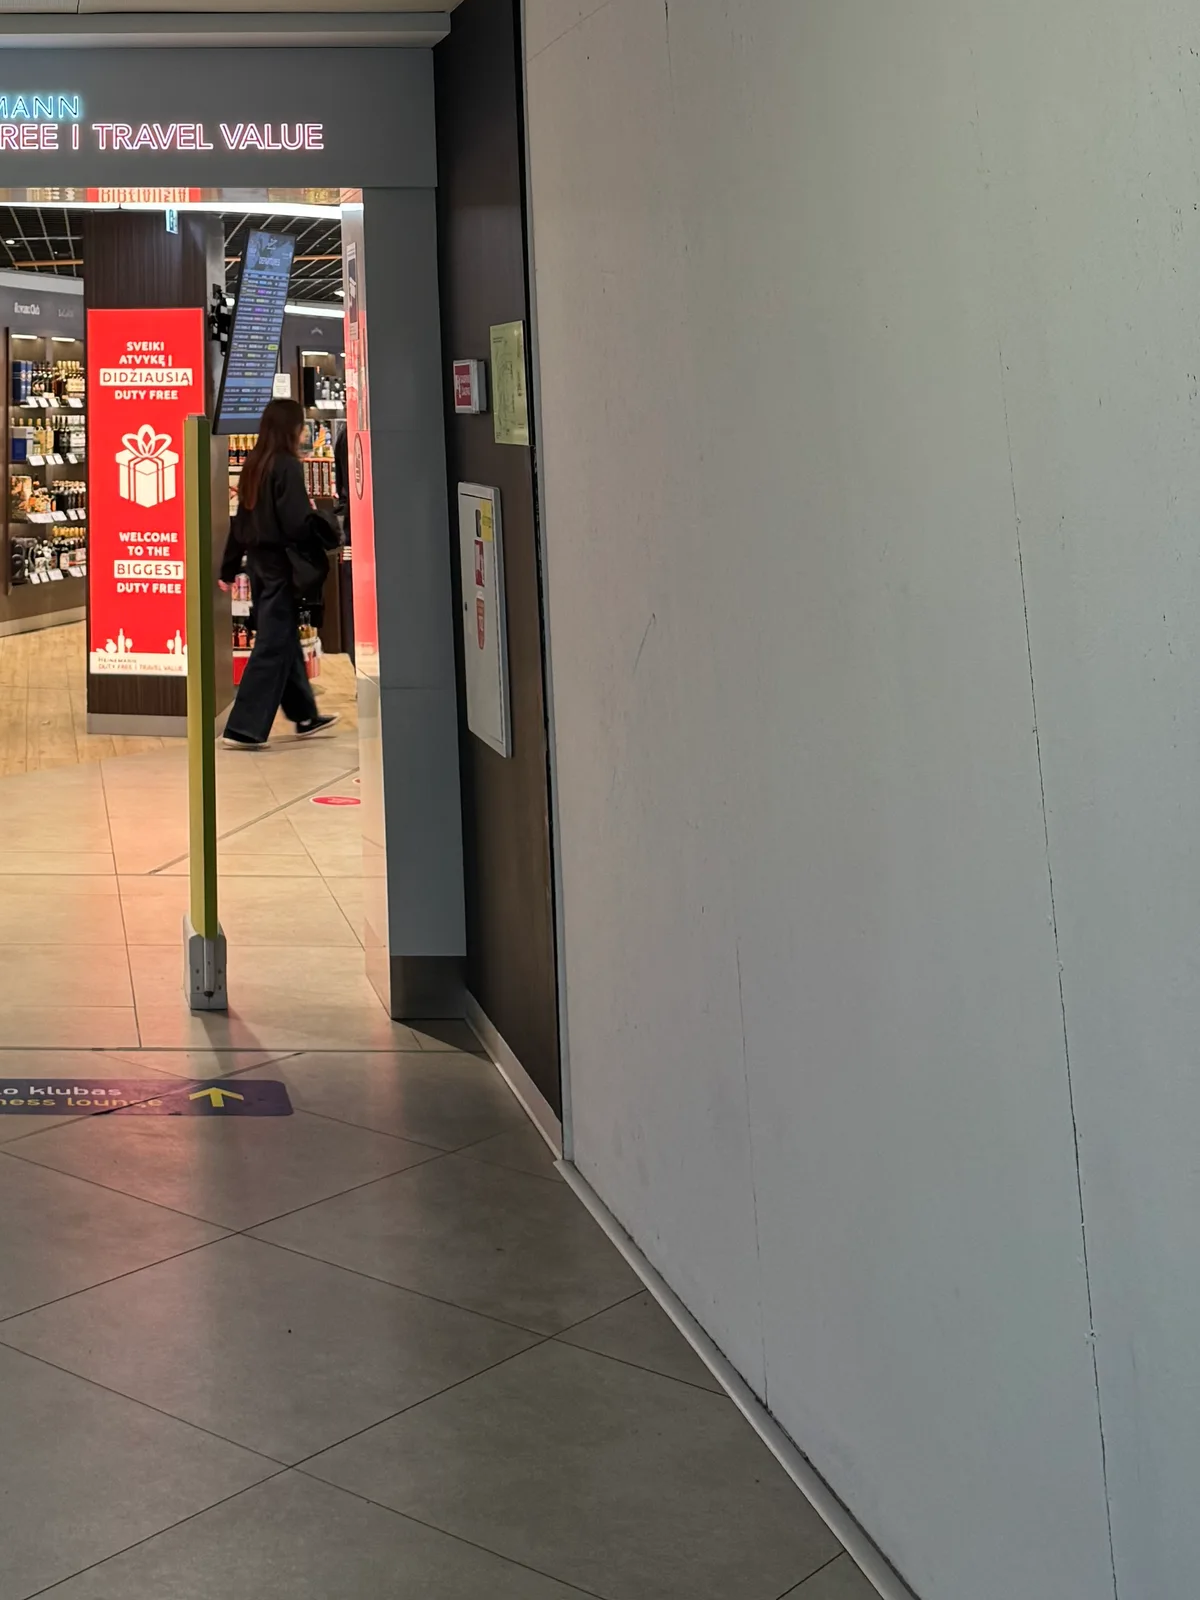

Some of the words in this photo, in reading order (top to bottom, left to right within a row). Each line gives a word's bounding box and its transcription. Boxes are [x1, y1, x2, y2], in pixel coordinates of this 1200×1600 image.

[92, 123, 214, 151] TRAVEL
[220, 123, 324, 151] VALUE
[126, 341, 164, 352] SVEIKI
[119, 354, 166, 367] ATVYKĘ
[102, 368, 191, 386] DIDŽIAUSIĄ
[114, 390, 146, 400] DUTY
[149, 390, 179, 401] FREE
[119, 532, 178, 543] WELCOME
[127, 545, 144, 557] TO
[146, 546, 170, 557] THE
[117, 563, 181, 576] BIGGEST
[116, 582, 149, 593] DUTY
[152, 583, 182, 594] FREE
[29, 1085, 122, 1096] klubas
